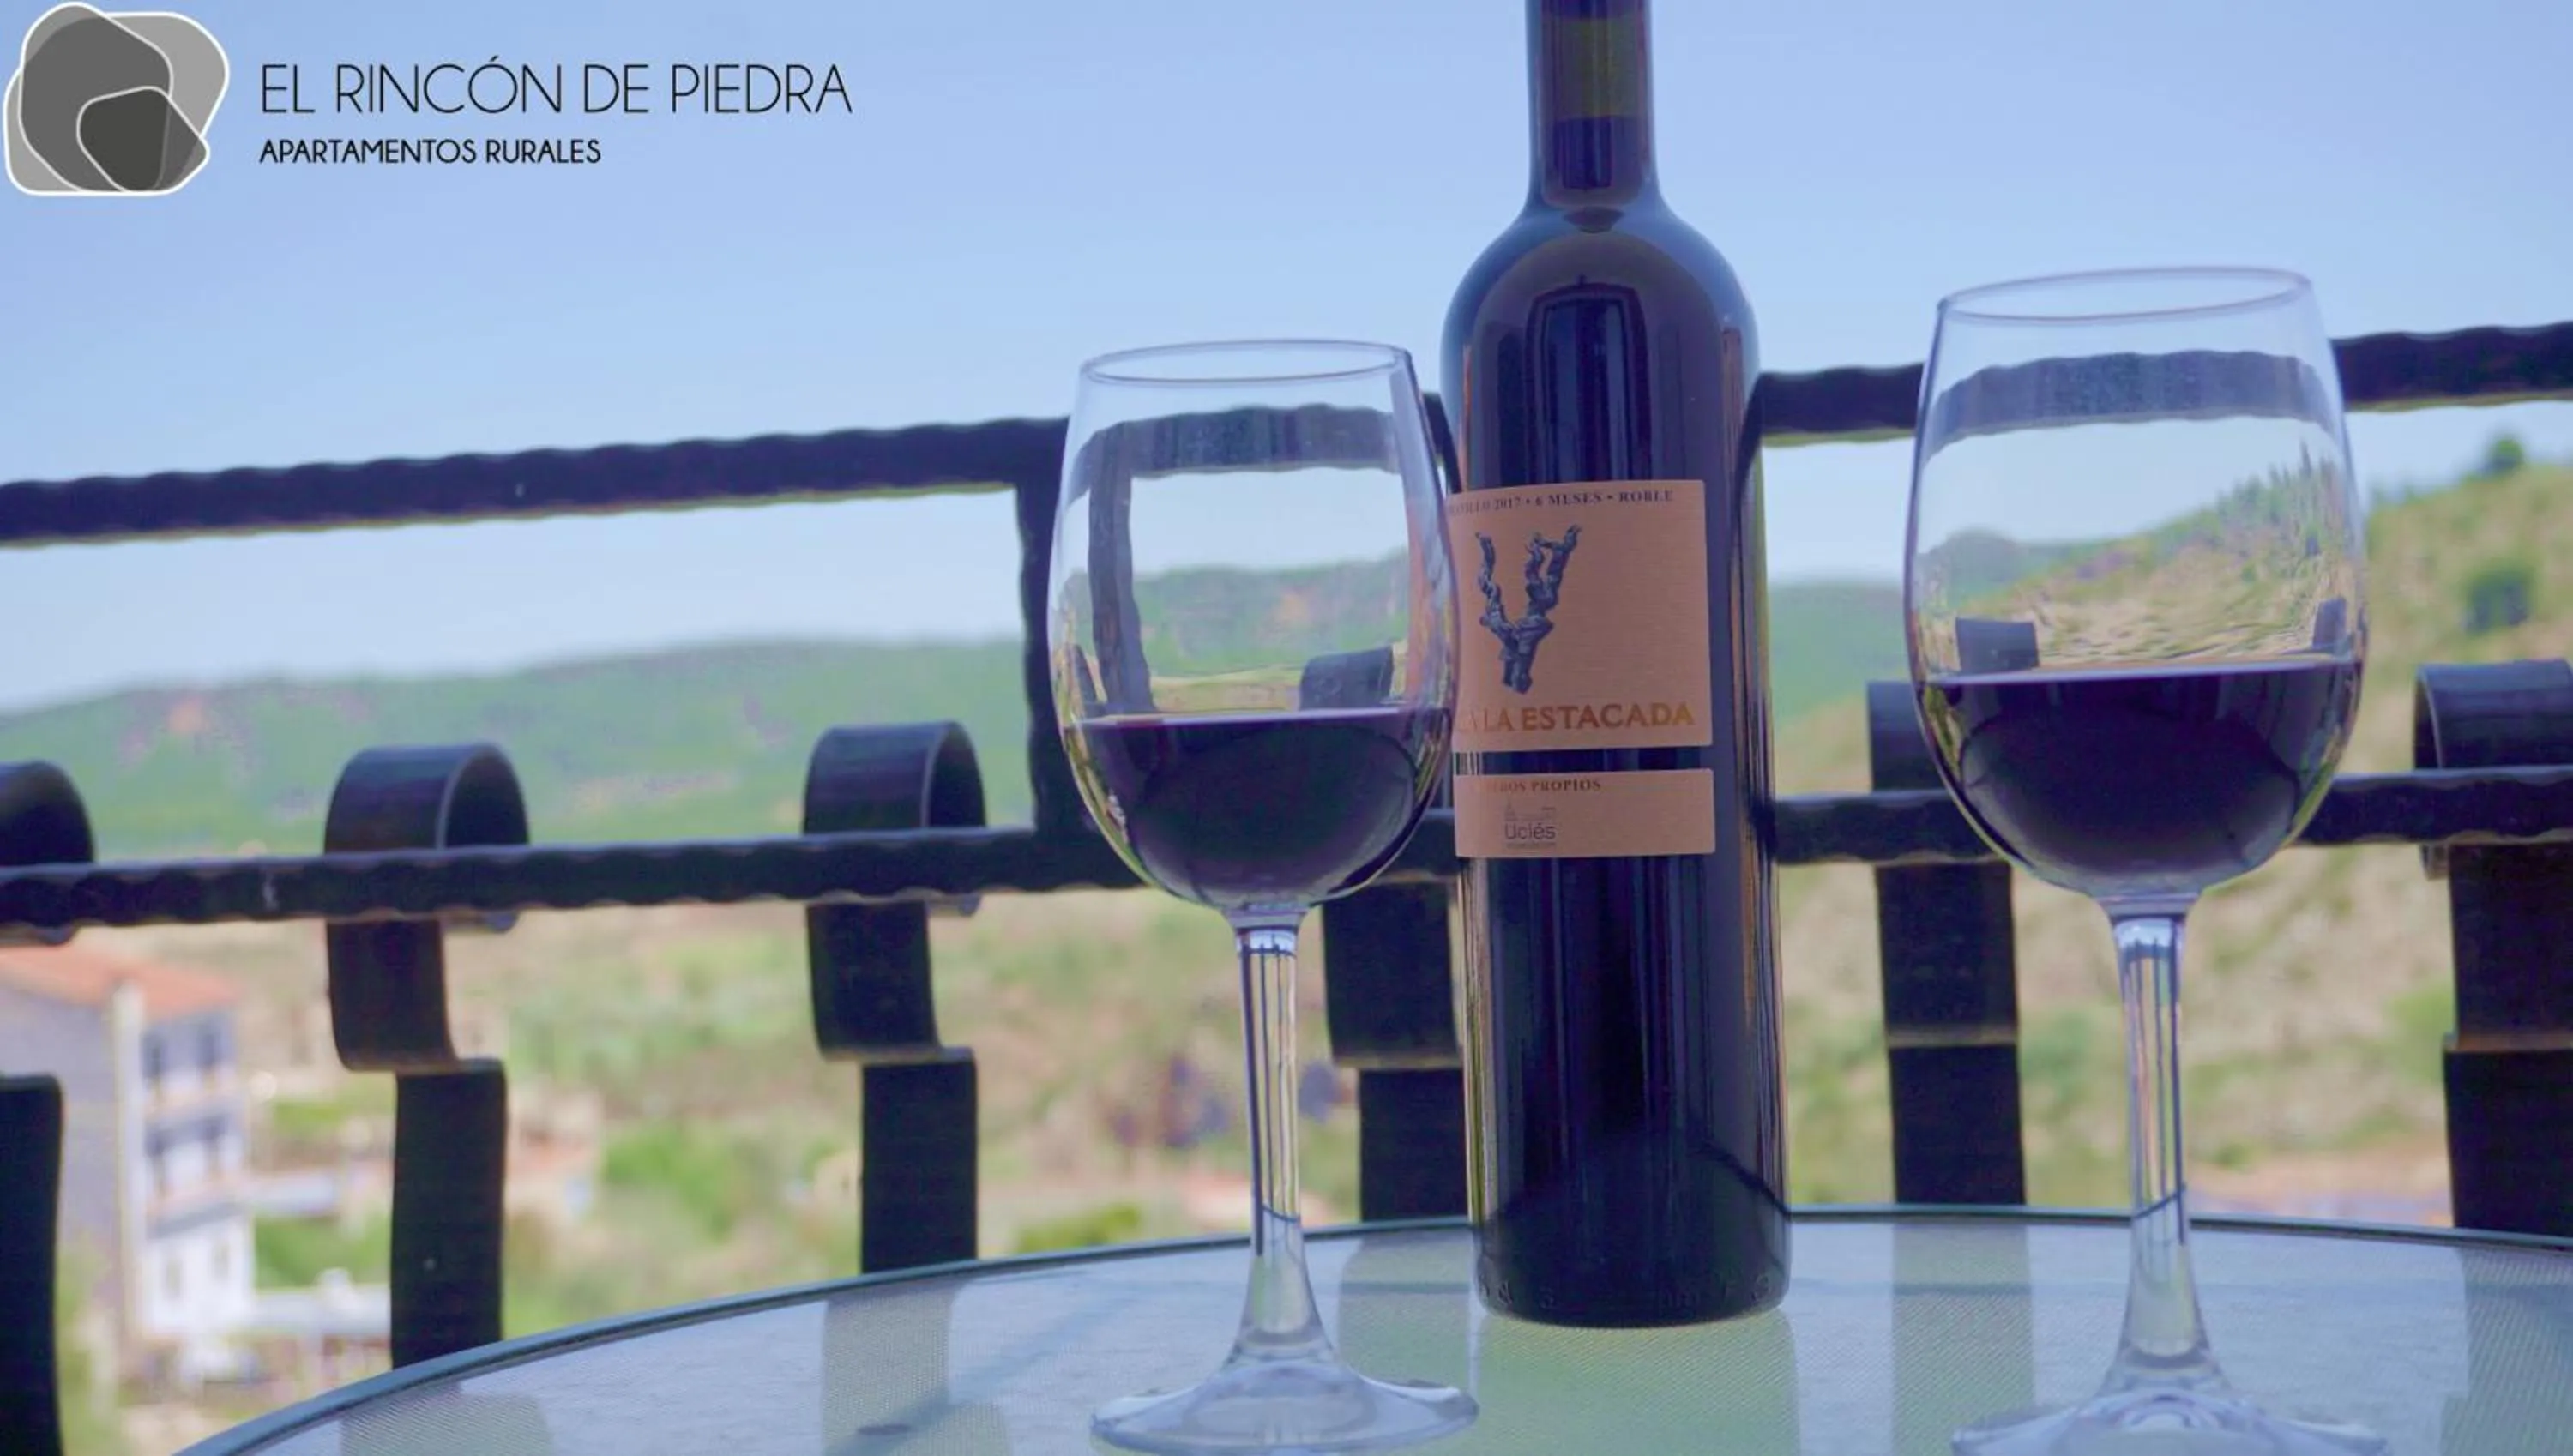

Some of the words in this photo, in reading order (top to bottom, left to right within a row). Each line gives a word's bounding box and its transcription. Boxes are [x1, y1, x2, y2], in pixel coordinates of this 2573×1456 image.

[1547, 490, 1602, 506] MESES
[1618, 490, 1674, 503] ROBLE
[1521, 701, 1696, 731] ESTACADA
[1530, 779, 1602, 792] PROPIOS
[1503, 821, 1557, 840] Uclés
